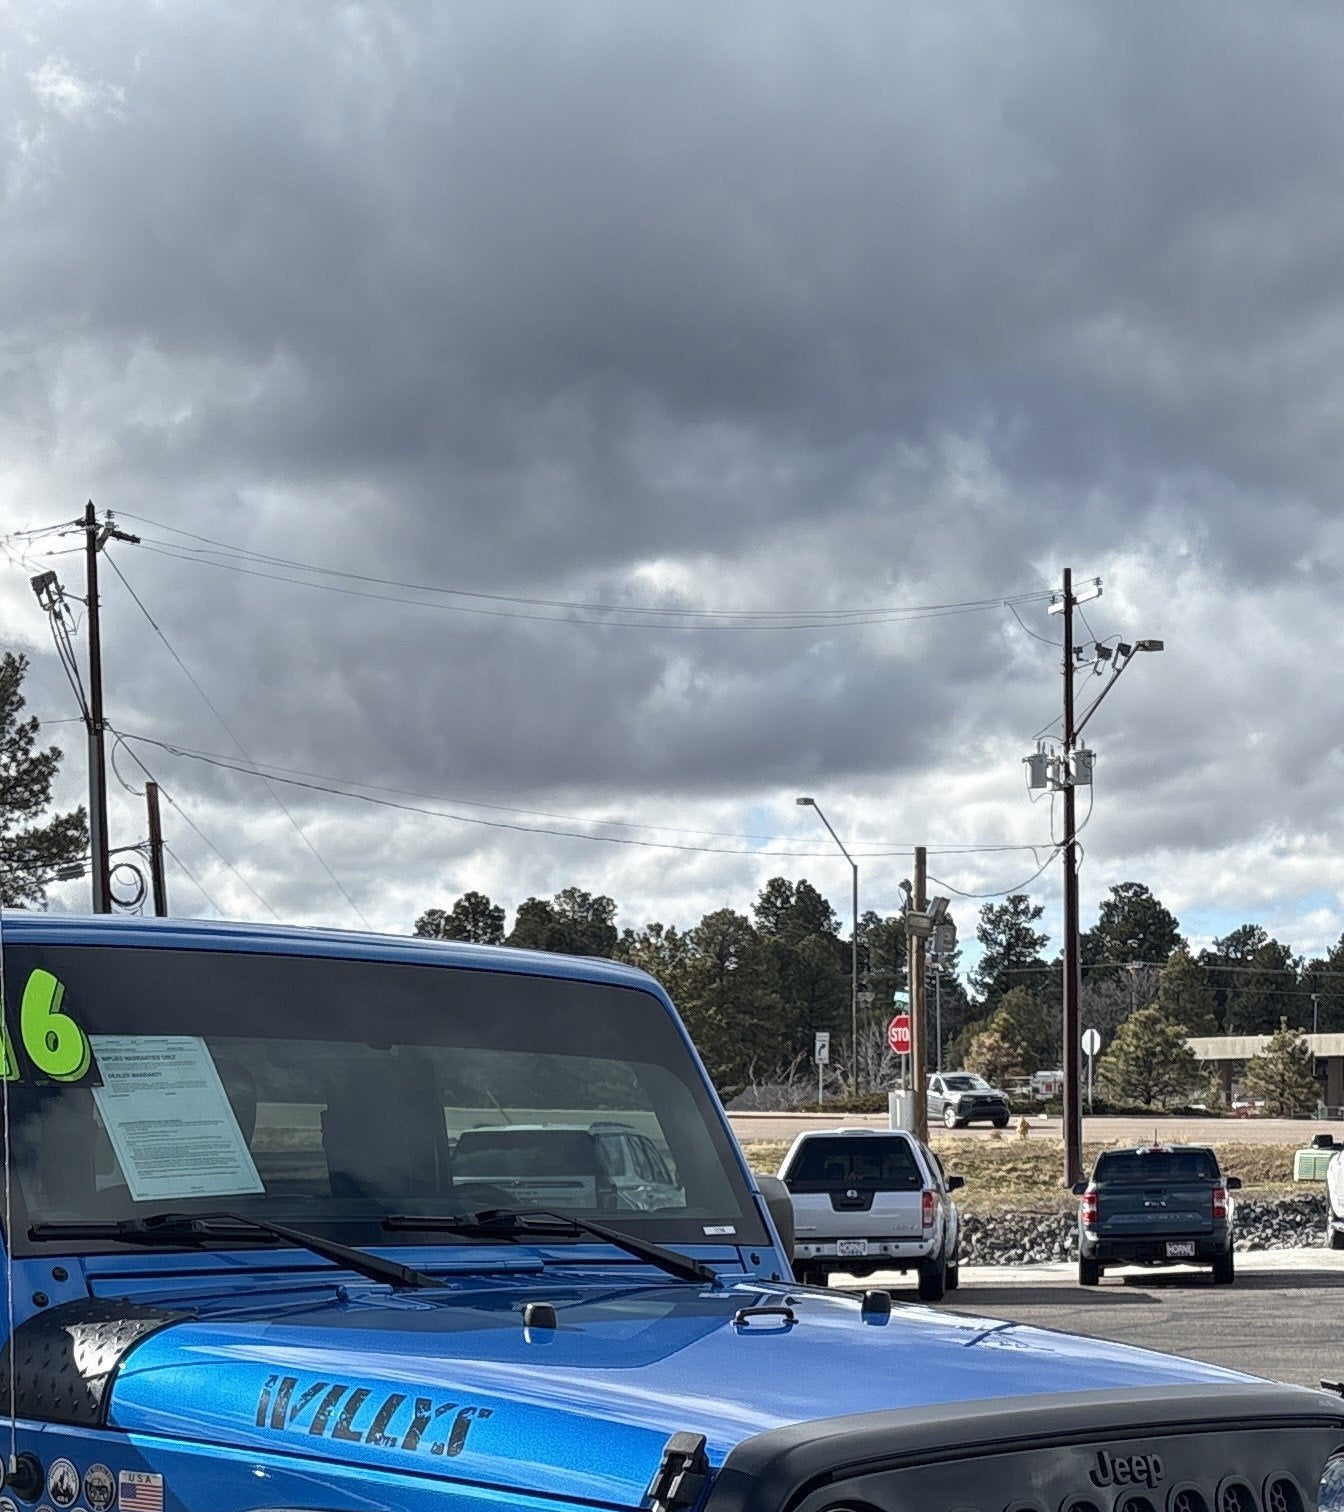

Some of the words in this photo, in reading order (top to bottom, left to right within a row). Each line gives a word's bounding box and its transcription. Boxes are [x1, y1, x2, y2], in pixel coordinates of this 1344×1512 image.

[891, 1027, 910, 1042] STO
[256, 1374, 493, 1457] WILLYS
[128, 1473, 153, 1484] USA
[1090, 1451, 1164, 1489] Jeep
